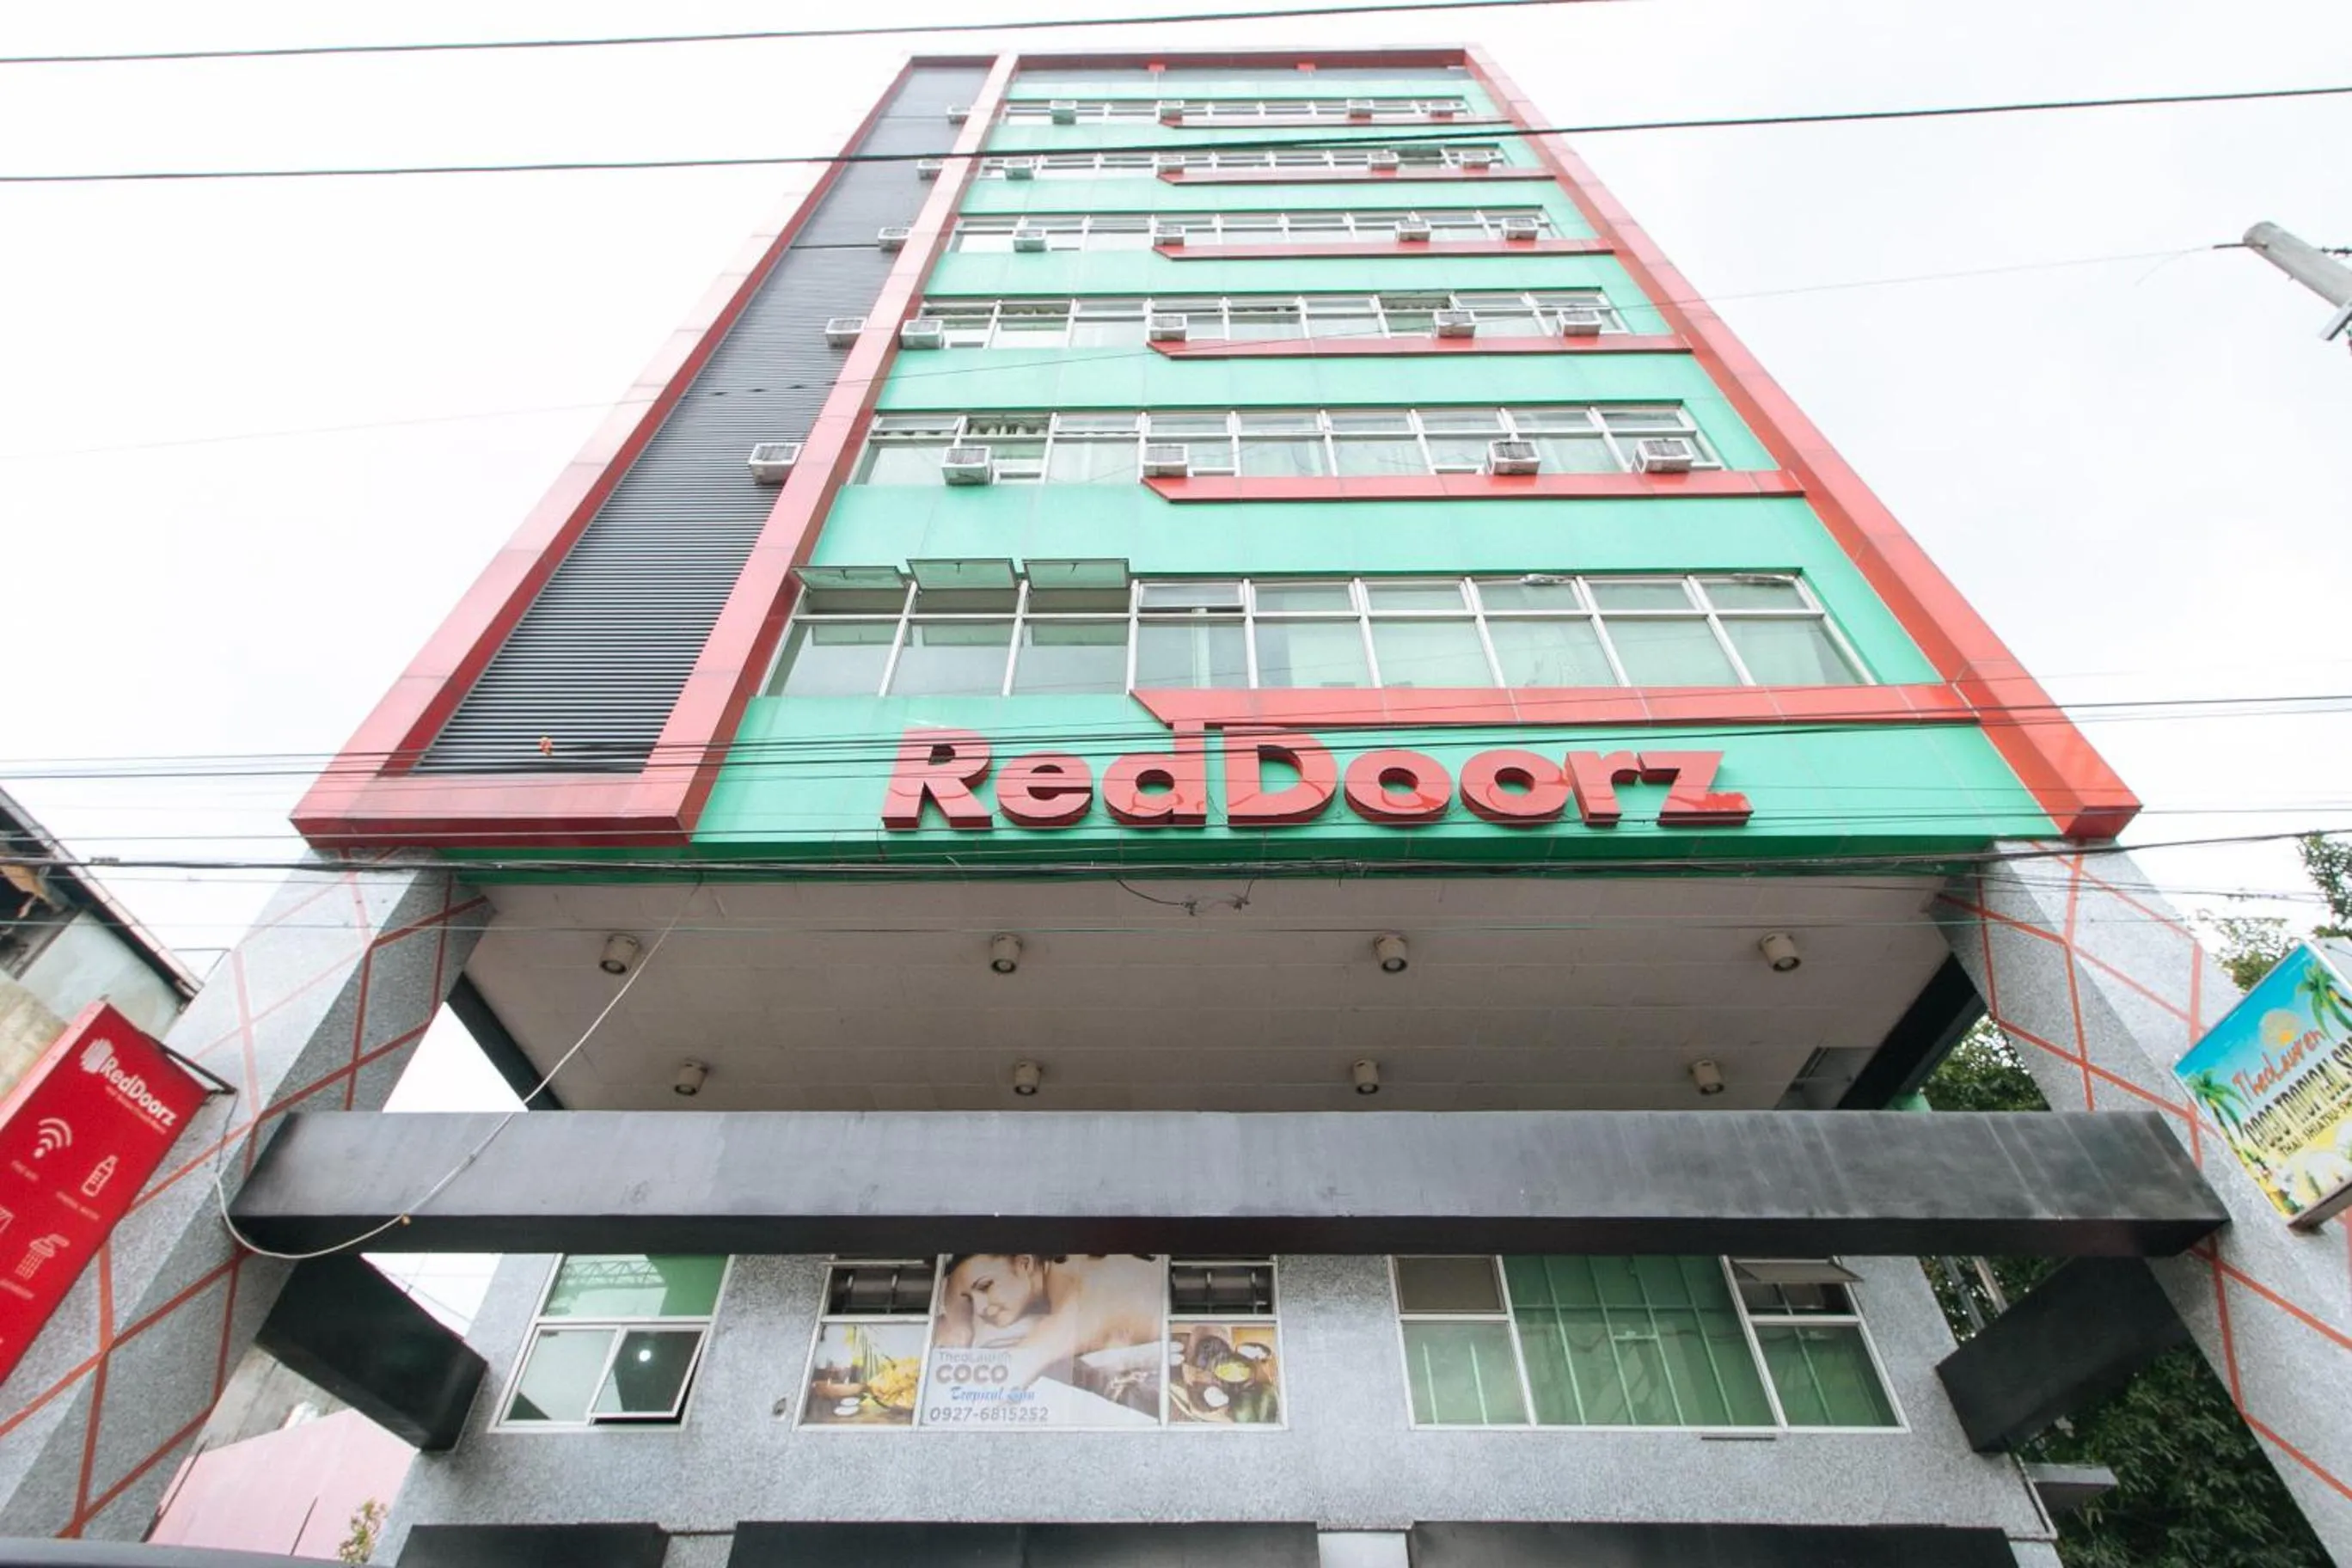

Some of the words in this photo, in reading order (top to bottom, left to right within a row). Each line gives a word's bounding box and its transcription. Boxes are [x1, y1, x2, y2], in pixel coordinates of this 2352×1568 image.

[882, 720, 1755, 828] RedDoorz
[100, 1056, 177, 1126] RedDoorz
[935, 1363, 1009, 1384] COCO
[929, 1406, 1050, 1422] 0927-6815252
